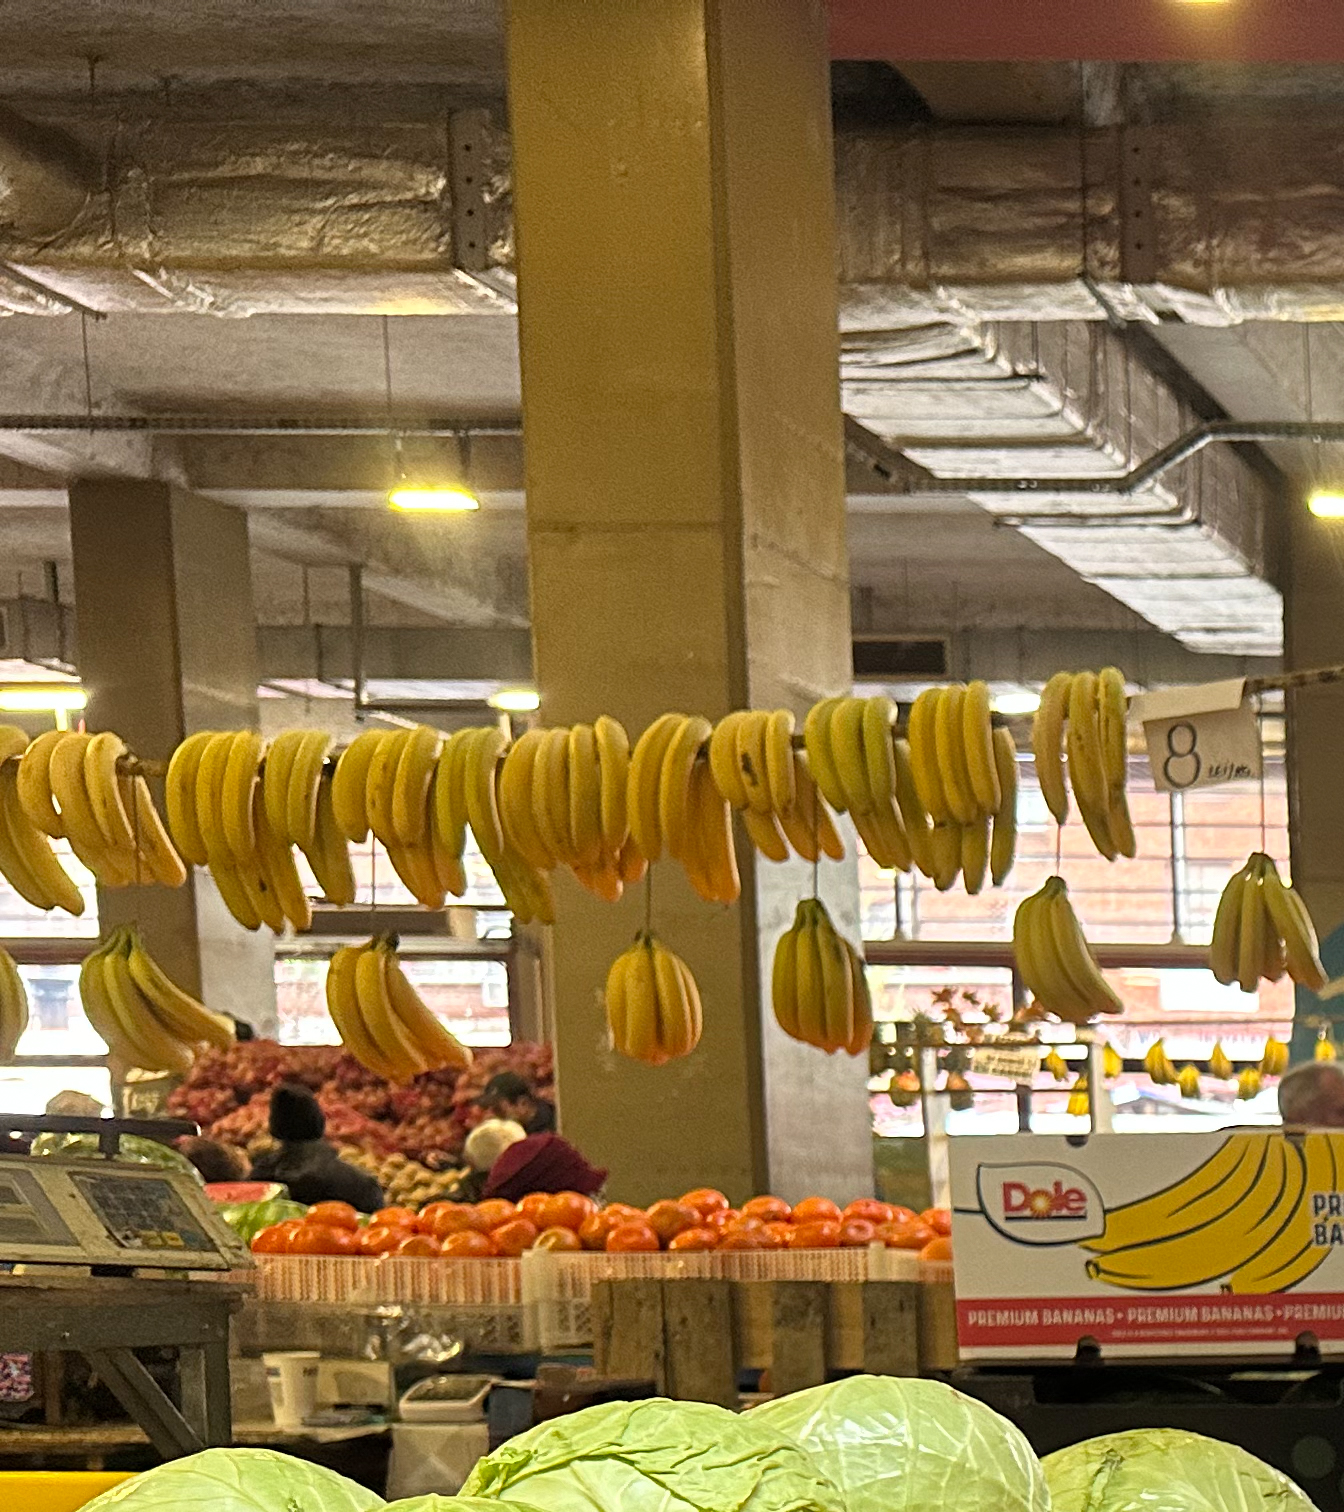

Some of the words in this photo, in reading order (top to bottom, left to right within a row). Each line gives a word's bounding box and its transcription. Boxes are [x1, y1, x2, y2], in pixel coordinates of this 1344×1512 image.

[1164, 720, 1201, 789] 8
[1003, 1180, 1087, 1216] Dole
[967, 1309, 1039, 1327] PREMIUM
[1042, 1307, 1115, 1326] BANANAS
[1127, 1305, 1198, 1324] PREMIUM
[1201, 1303, 1274, 1322] BANANAS
